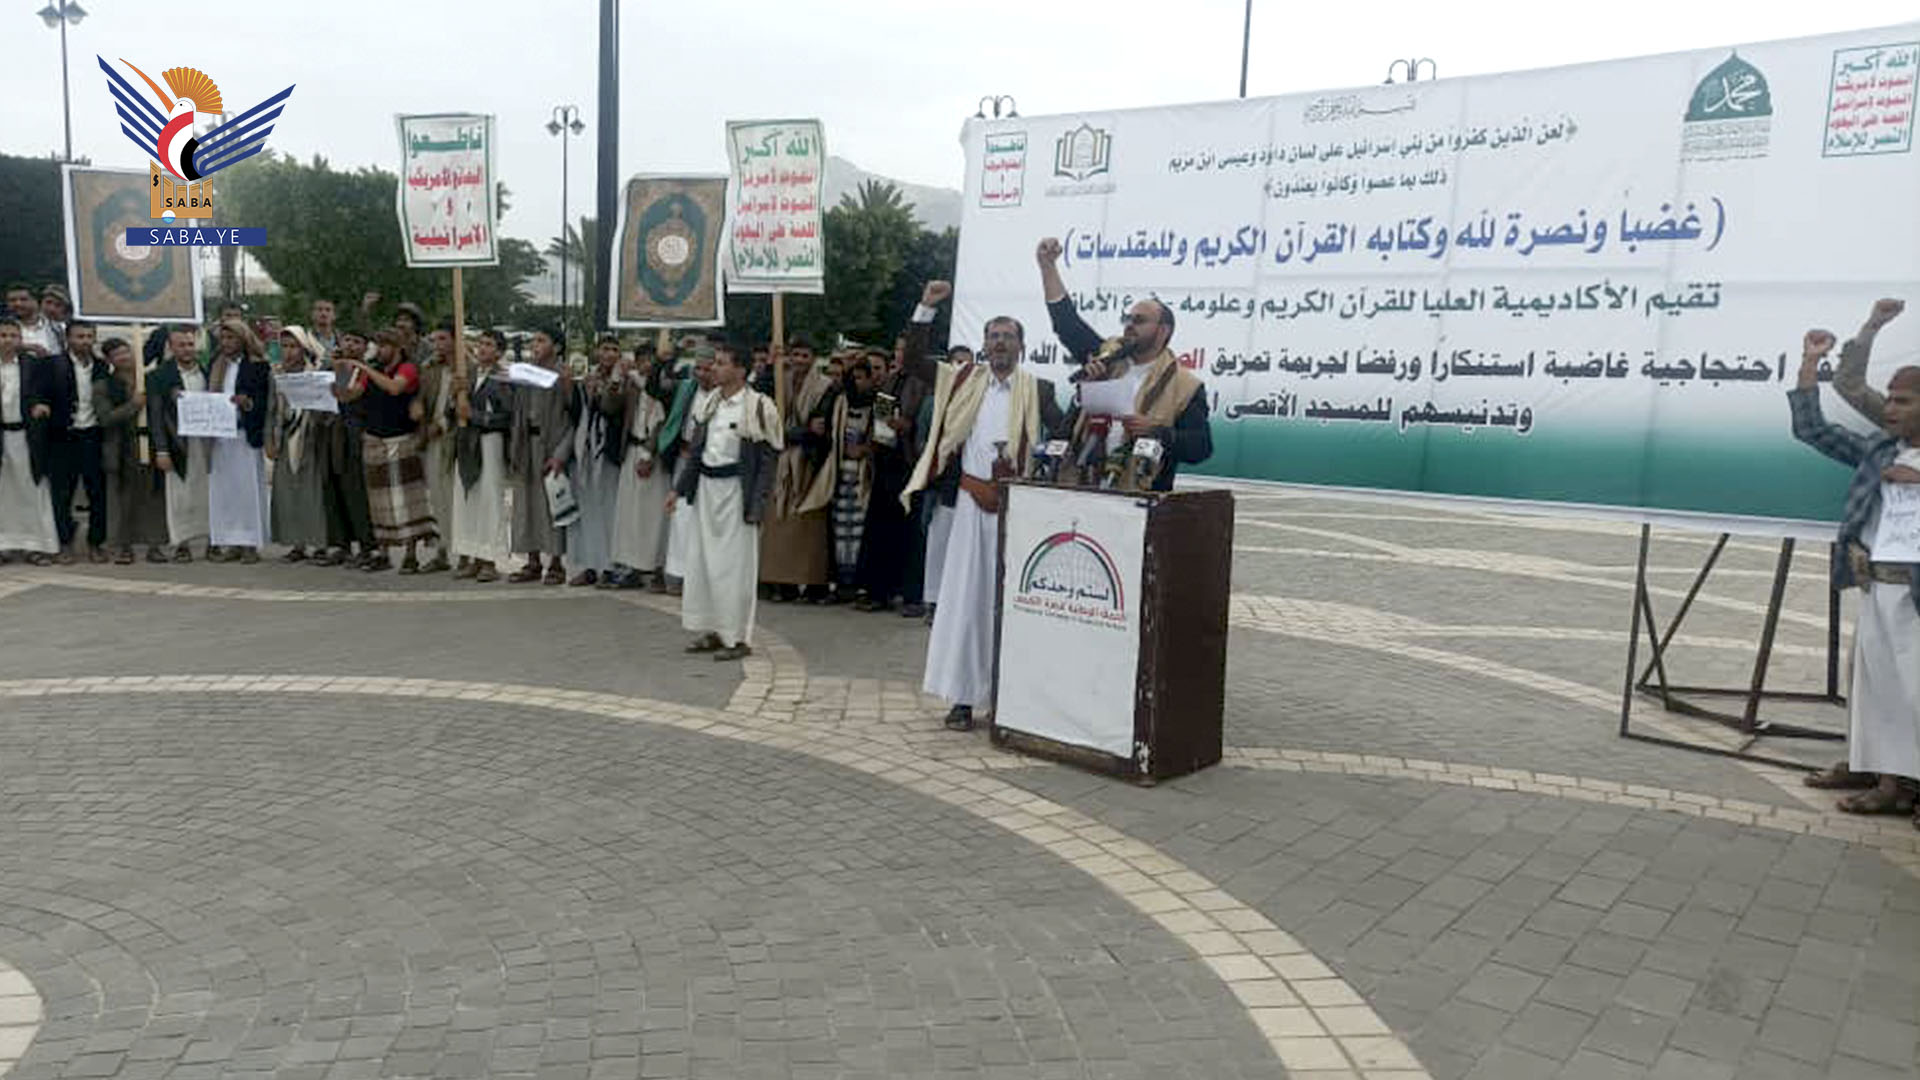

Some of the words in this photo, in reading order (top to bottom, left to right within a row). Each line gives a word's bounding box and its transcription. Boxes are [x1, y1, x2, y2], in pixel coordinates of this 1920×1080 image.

[1195, 225, 1267, 267] الكريم
[1275, 221, 1357, 263] القرآن
[1367, 216, 1448, 261] وكتابه
[1456, 209, 1496, 248] لله
[1504, 209, 1607, 256] ونصرة
[1180, 292, 1255, 319] وعلومه
[1261, 288, 1334, 320] الكريم
[1340, 287, 1416, 319] للقرآن
[1423, 289, 1485, 317] العليا
[1493, 278, 1637, 318] الأكاديمية
[1646, 281, 1722, 317] تقيم
[1211, 347, 1271, 377] تمزيق
[1279, 347, 1348, 380] لجريمة
[1544, 350, 1629, 385] غاضبة
[1642, 350, 1787, 387] احتجاجية
[1226, 388, 1297, 420] الأقصى
[1305, 397, 1392, 425] للمسجد
[1401, 398, 1534, 433] وتدنيسهم
